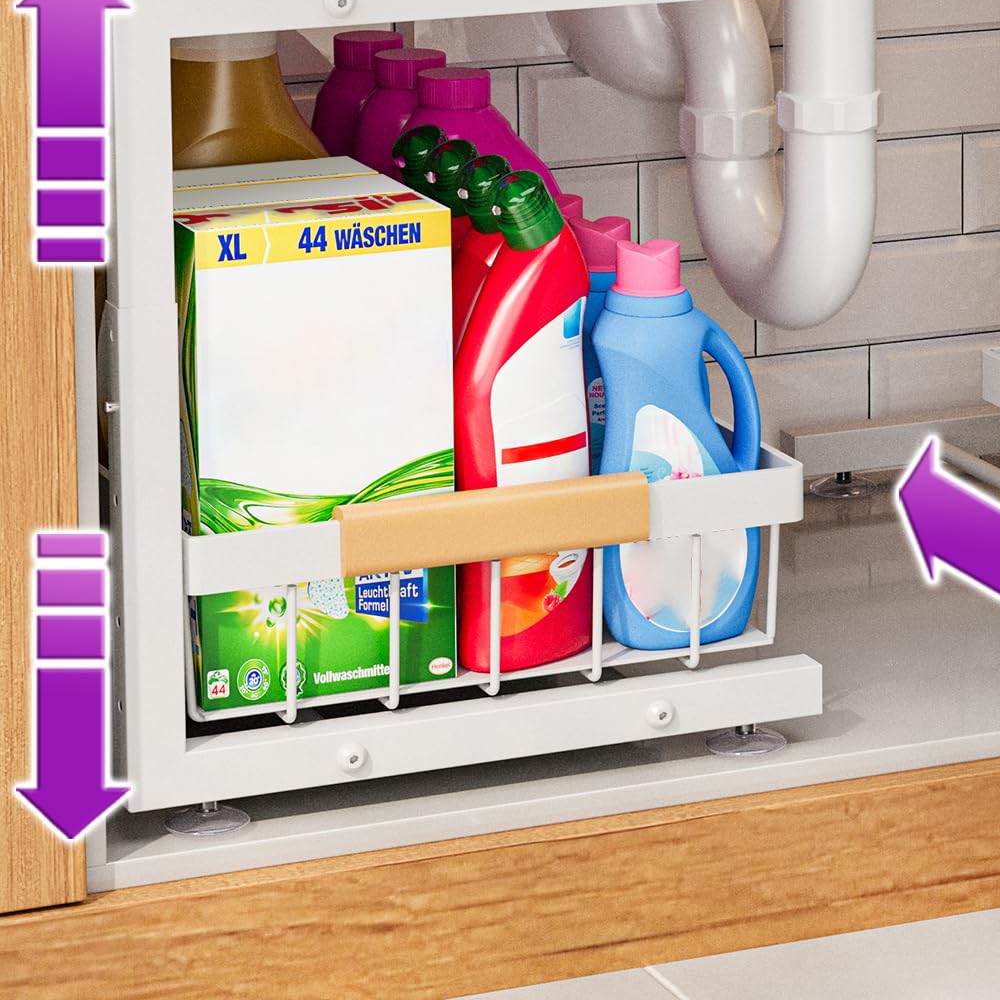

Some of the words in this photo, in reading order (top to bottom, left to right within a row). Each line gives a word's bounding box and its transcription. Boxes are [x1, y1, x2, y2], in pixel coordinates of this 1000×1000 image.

[298, 225, 328, 254] 44
[334, 221, 422, 251] WÄSCHEN
[217, 233, 247, 262] XL
[358, 582, 419, 598] Leuchtaft
[358, 598, 389, 612] Formel
[313, 663, 391, 685] Vollwaschmitte
[211, 684, 226, 696] 44
